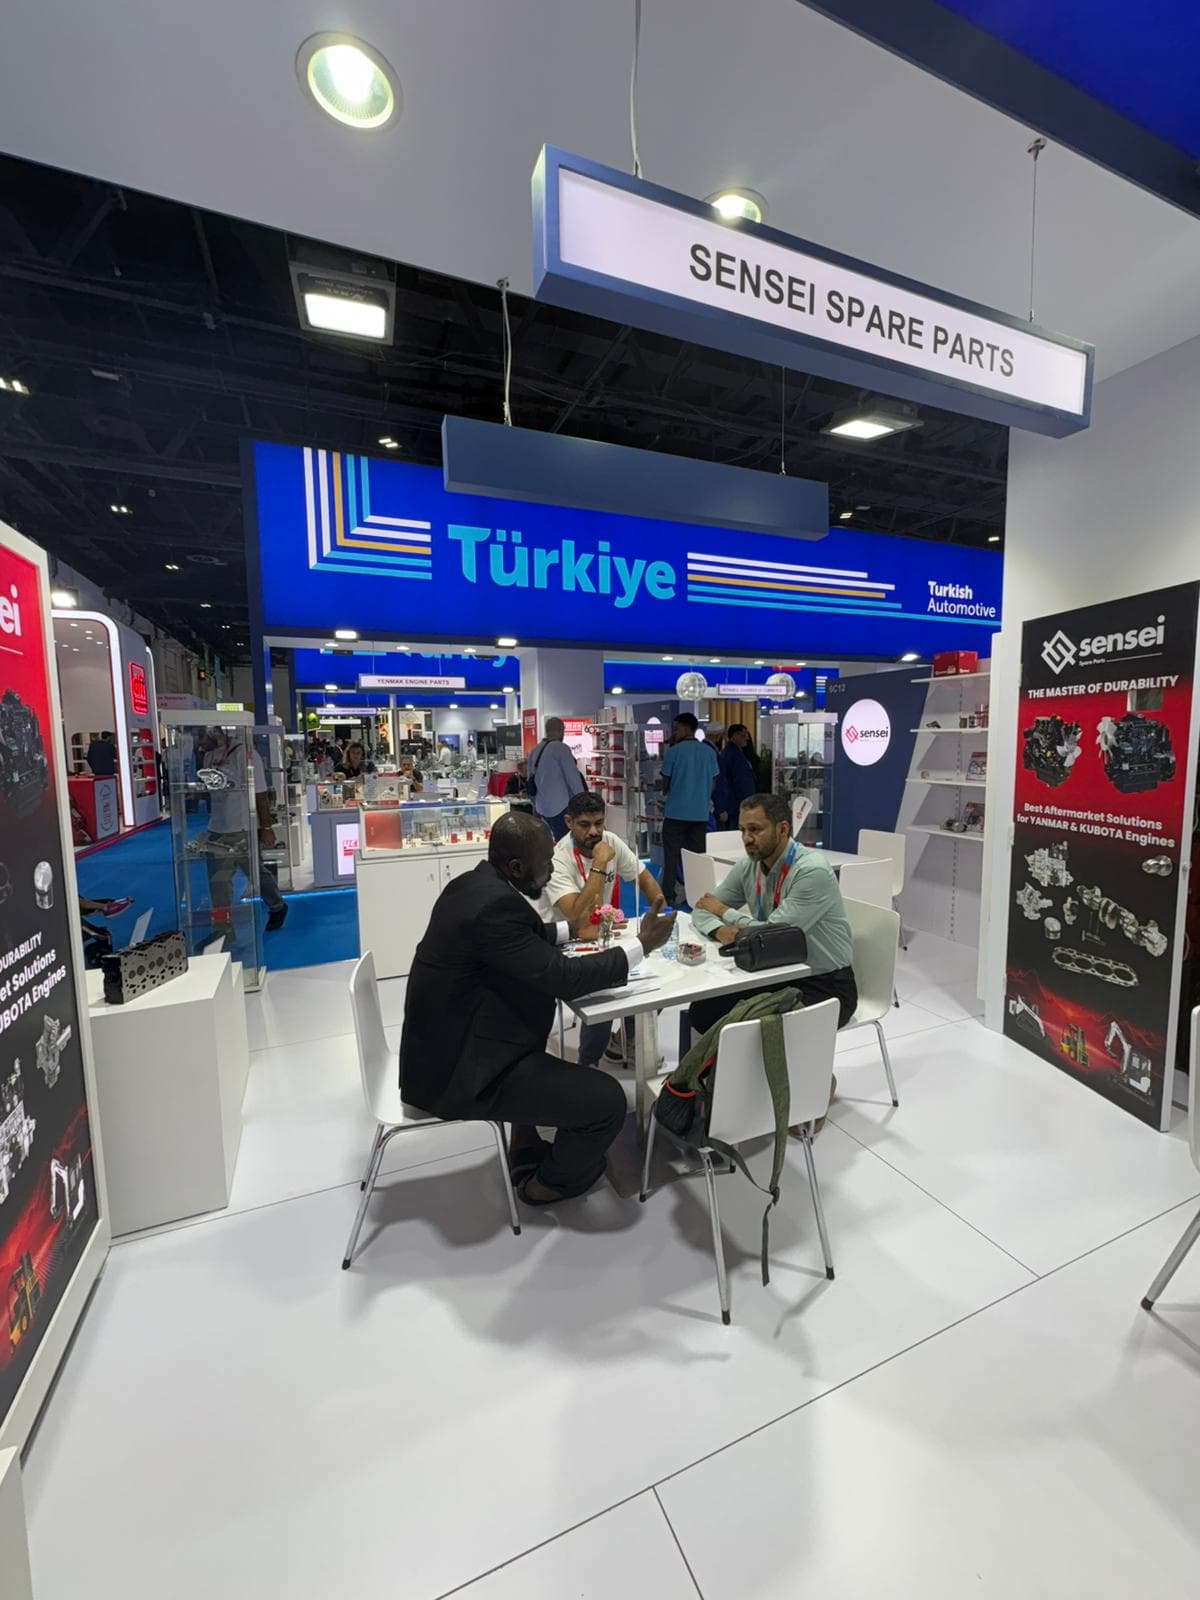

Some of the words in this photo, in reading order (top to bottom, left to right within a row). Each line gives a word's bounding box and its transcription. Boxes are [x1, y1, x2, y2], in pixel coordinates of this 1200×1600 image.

[690, 243, 815, 316] SENSEI
[826, 290, 924, 350] SPARE
[933, 325, 1014, 377] PARTS
[447, 524, 677, 609] Türkiye
[928, 580, 973, 600] Turkish
[927, 597, 996, 618] Automotive
[1079, 615, 1166, 657] sensei
[1028, 688, 1045, 699] THE
[1046, 684, 1086, 698] MASTER
[1087, 682, 1103, 694] OF
[1104, 675, 1179, 692] DURABILITY
[860, 726, 889, 738] sensei
[1017, 814, 1029, 823] for
[1030, 816, 1069, 830] YANMAR
[1070, 822, 1078, 832] &
[1080, 824, 1123, 840] KUBOTA
[1125, 831, 1175, 848] Engines
[1024, 803, 1043, 813] Best
[1044, 805, 1105, 822] Aftermarket
[1106, 813, 1163, 830] Solutions
[12, 949, 56, 992] Solutions
[32, 965, 66, 1003] Engines
